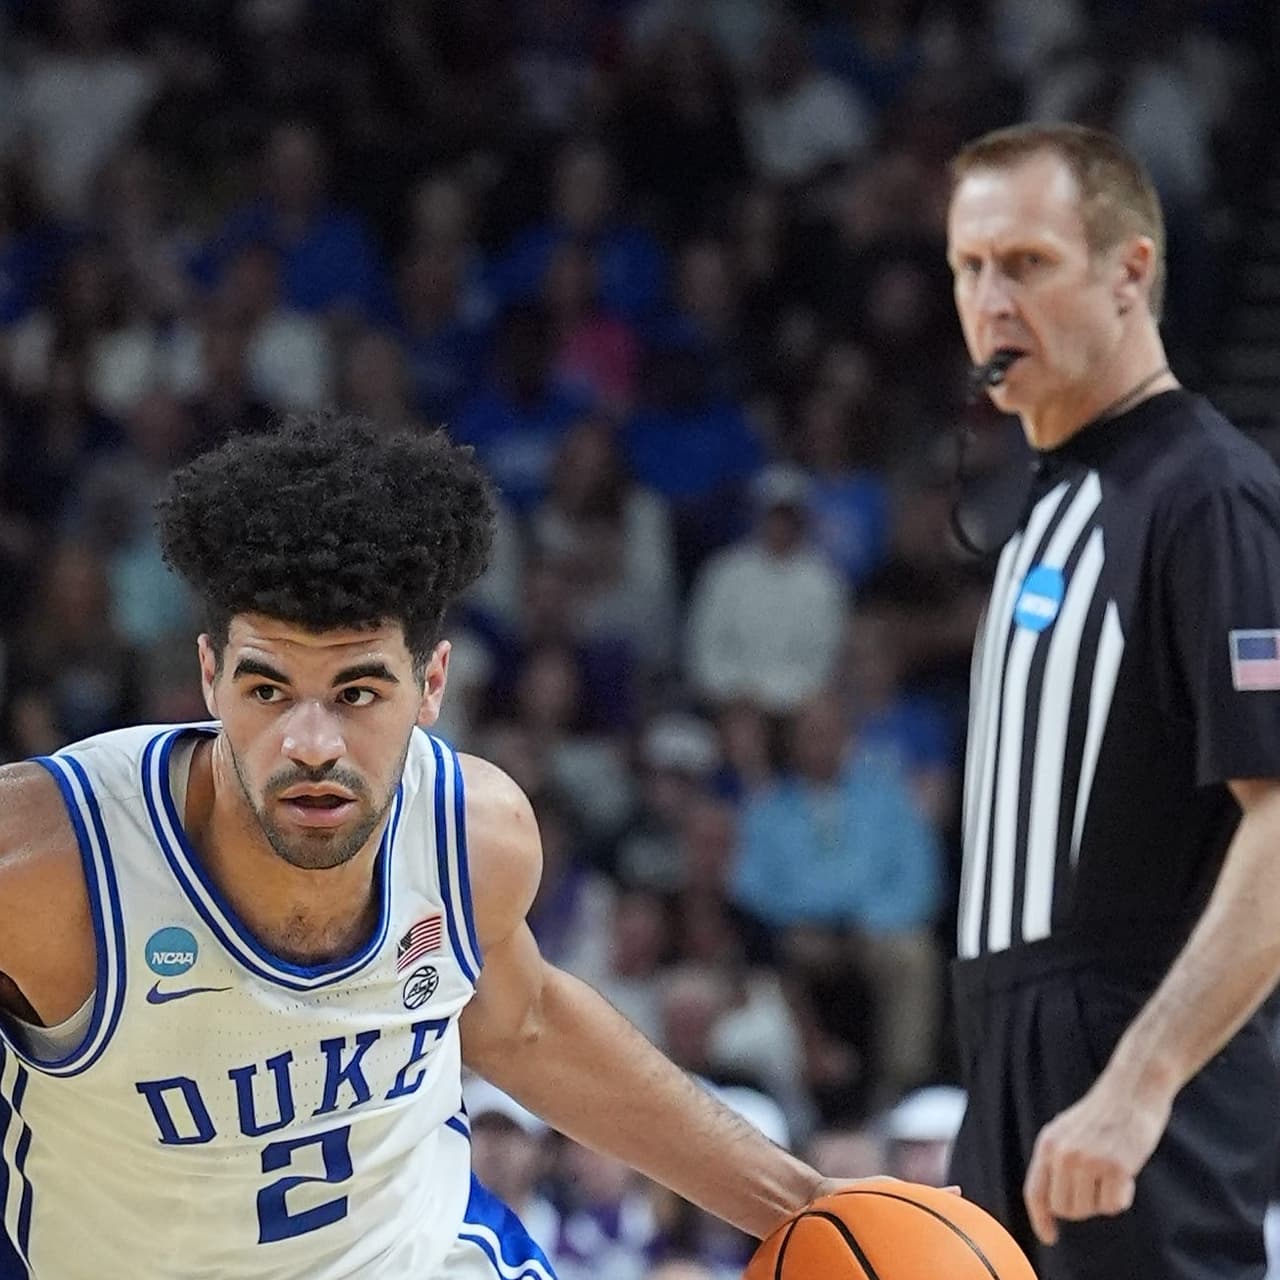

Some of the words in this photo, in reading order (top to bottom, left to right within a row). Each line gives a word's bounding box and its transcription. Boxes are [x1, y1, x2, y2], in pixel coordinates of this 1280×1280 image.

[151, 951, 194, 966] NCAA
[135, 1017, 451, 1145] DUKE
[256, 1124, 354, 1245] 2
